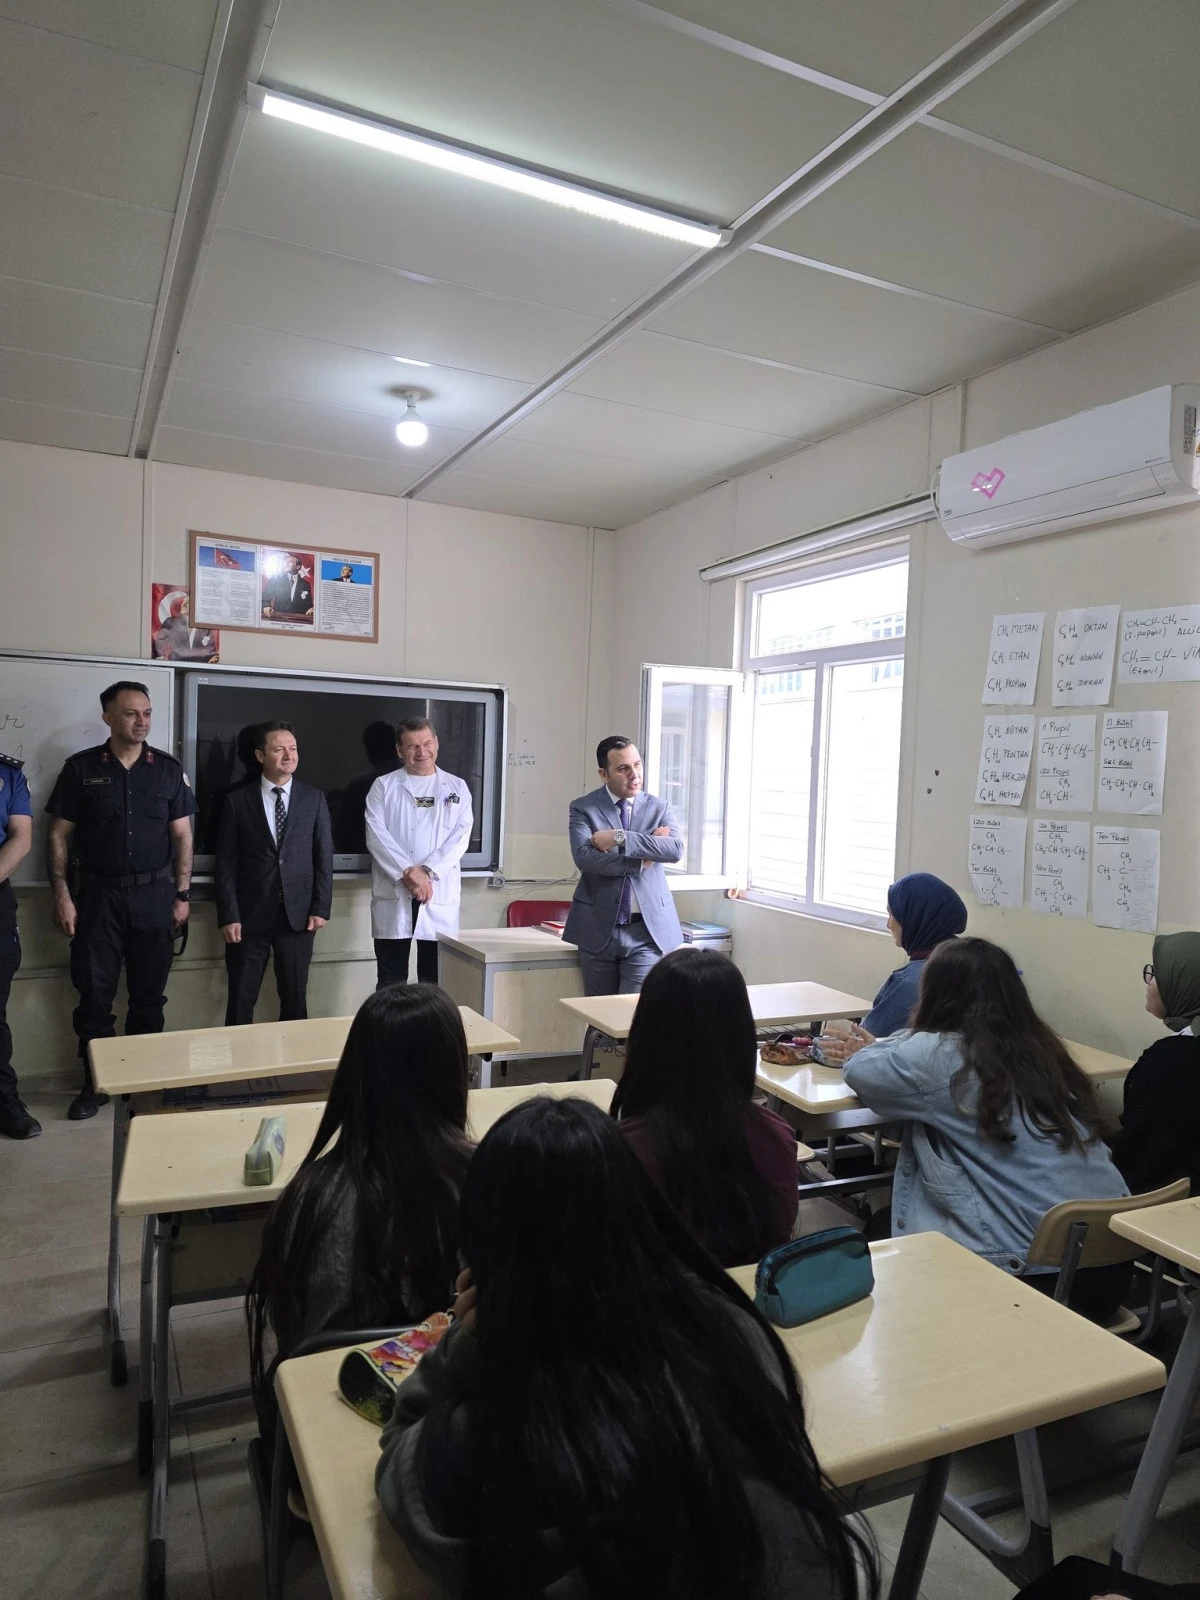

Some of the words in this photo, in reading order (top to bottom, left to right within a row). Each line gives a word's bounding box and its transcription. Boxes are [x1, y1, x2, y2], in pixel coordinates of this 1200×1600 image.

[1011, 624, 1039, 634] METAN
[1009, 651, 1030, 661] ETAN
[1003, 748, 1030, 759] PENTAN
[1002, 770, 1028, 782] HEKZA
